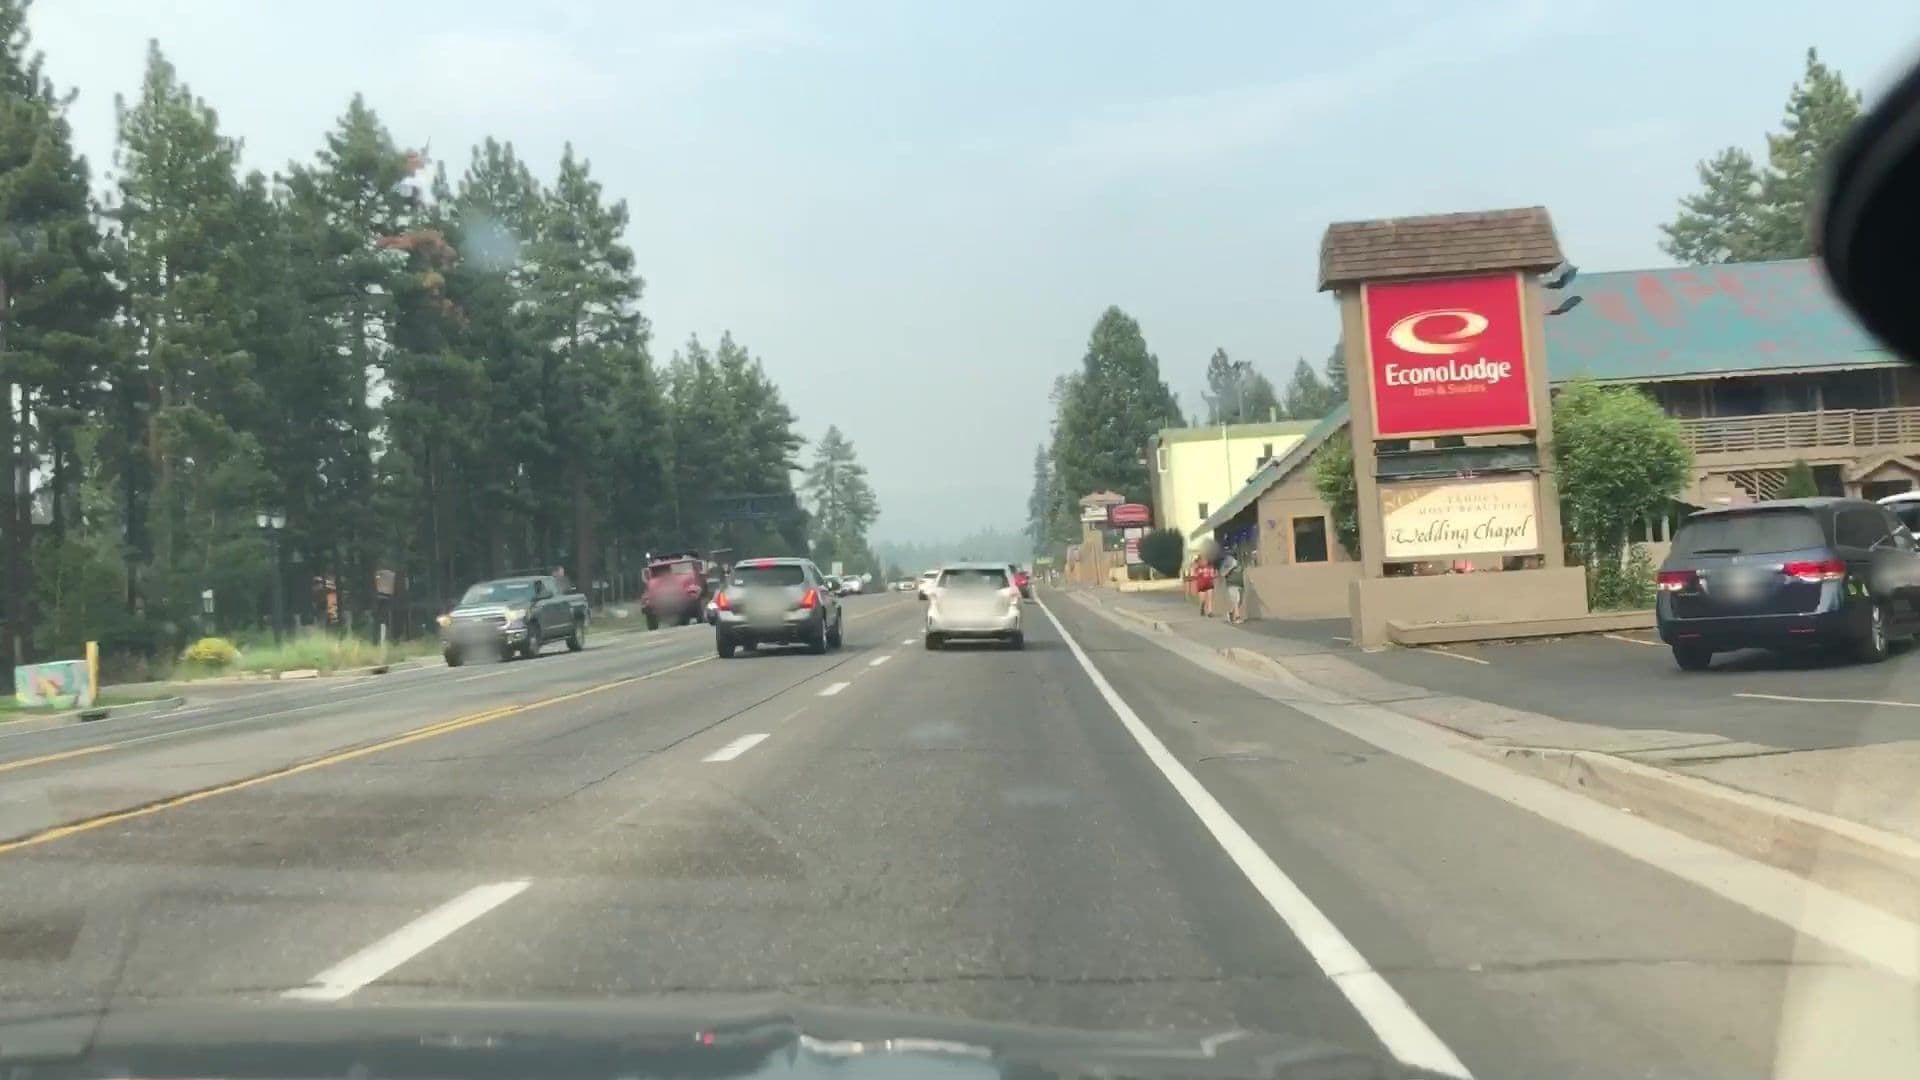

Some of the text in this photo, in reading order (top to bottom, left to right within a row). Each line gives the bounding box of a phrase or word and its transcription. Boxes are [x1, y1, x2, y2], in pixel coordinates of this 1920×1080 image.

[1385, 357, 1512, 386] EconoLodge
[1391, 514, 1533, 547] Wedding Chapel
